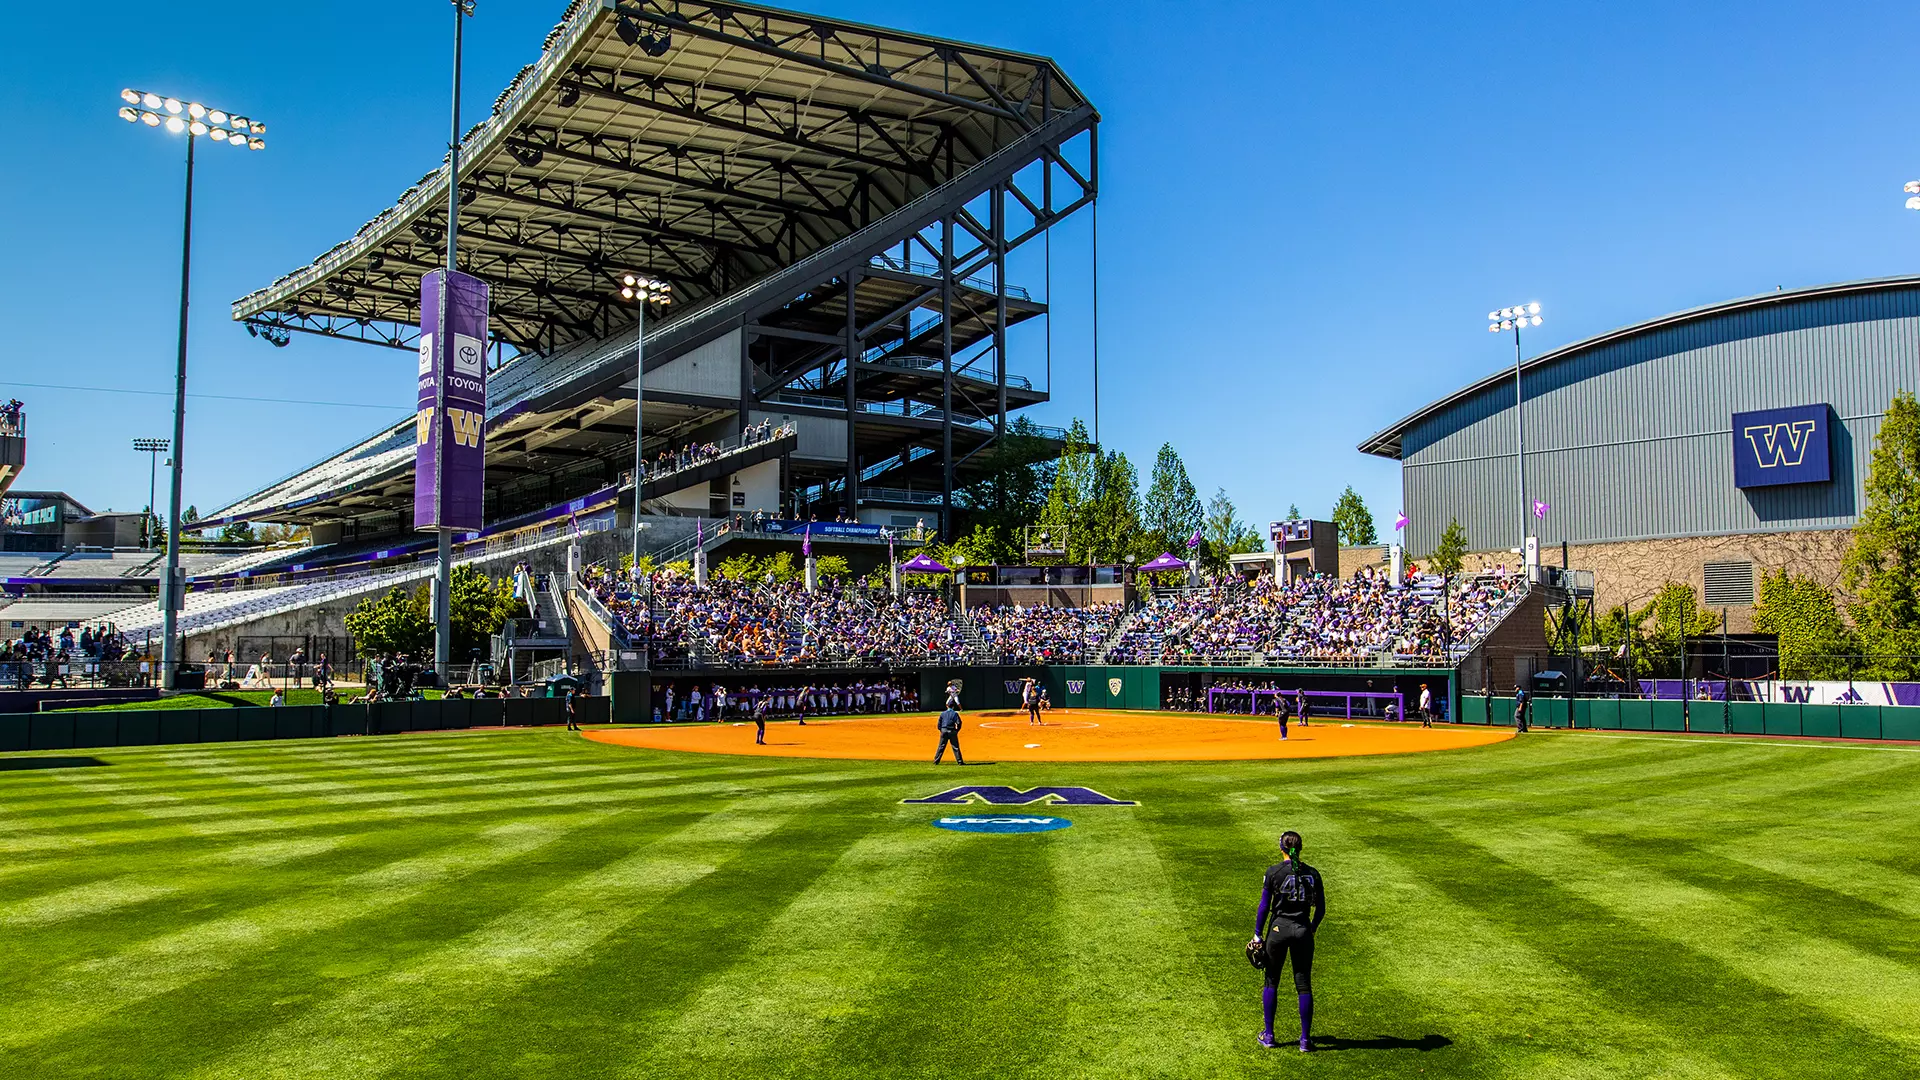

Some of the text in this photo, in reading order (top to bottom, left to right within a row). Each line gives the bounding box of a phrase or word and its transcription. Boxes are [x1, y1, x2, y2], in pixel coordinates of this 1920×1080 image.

[447, 376, 484, 394] TOYOTA
[447, 406, 483, 448] W
[1744, 420, 1815, 468] W
[1004, 680, 1023, 694] W
[1066, 680, 1085, 694] W
[1780, 686, 1814, 703] W
